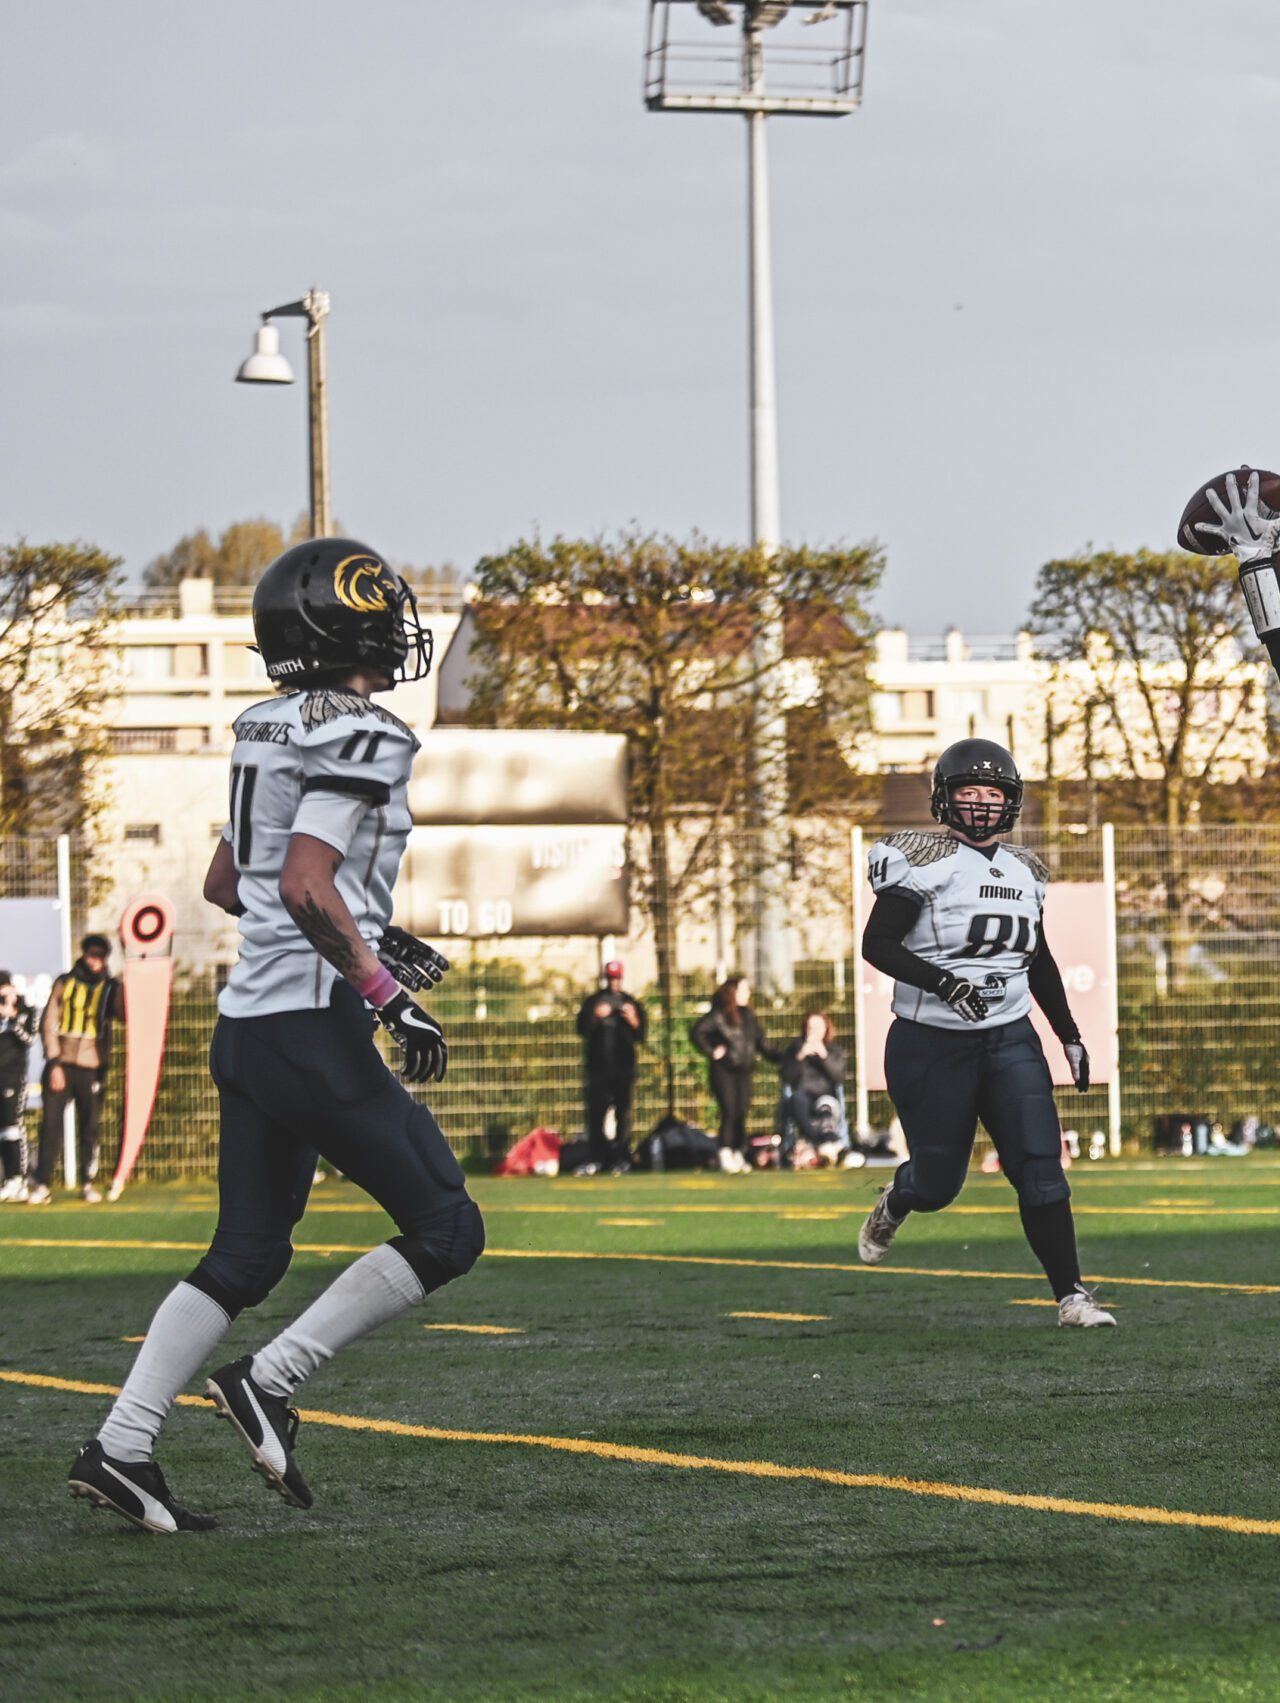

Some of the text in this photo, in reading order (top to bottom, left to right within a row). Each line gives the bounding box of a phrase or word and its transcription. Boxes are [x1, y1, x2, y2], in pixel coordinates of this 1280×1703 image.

[338, 729, 388, 763] 11
[979, 884, 1024, 901] MAINZ
[438, 900, 513, 935] TO GO
